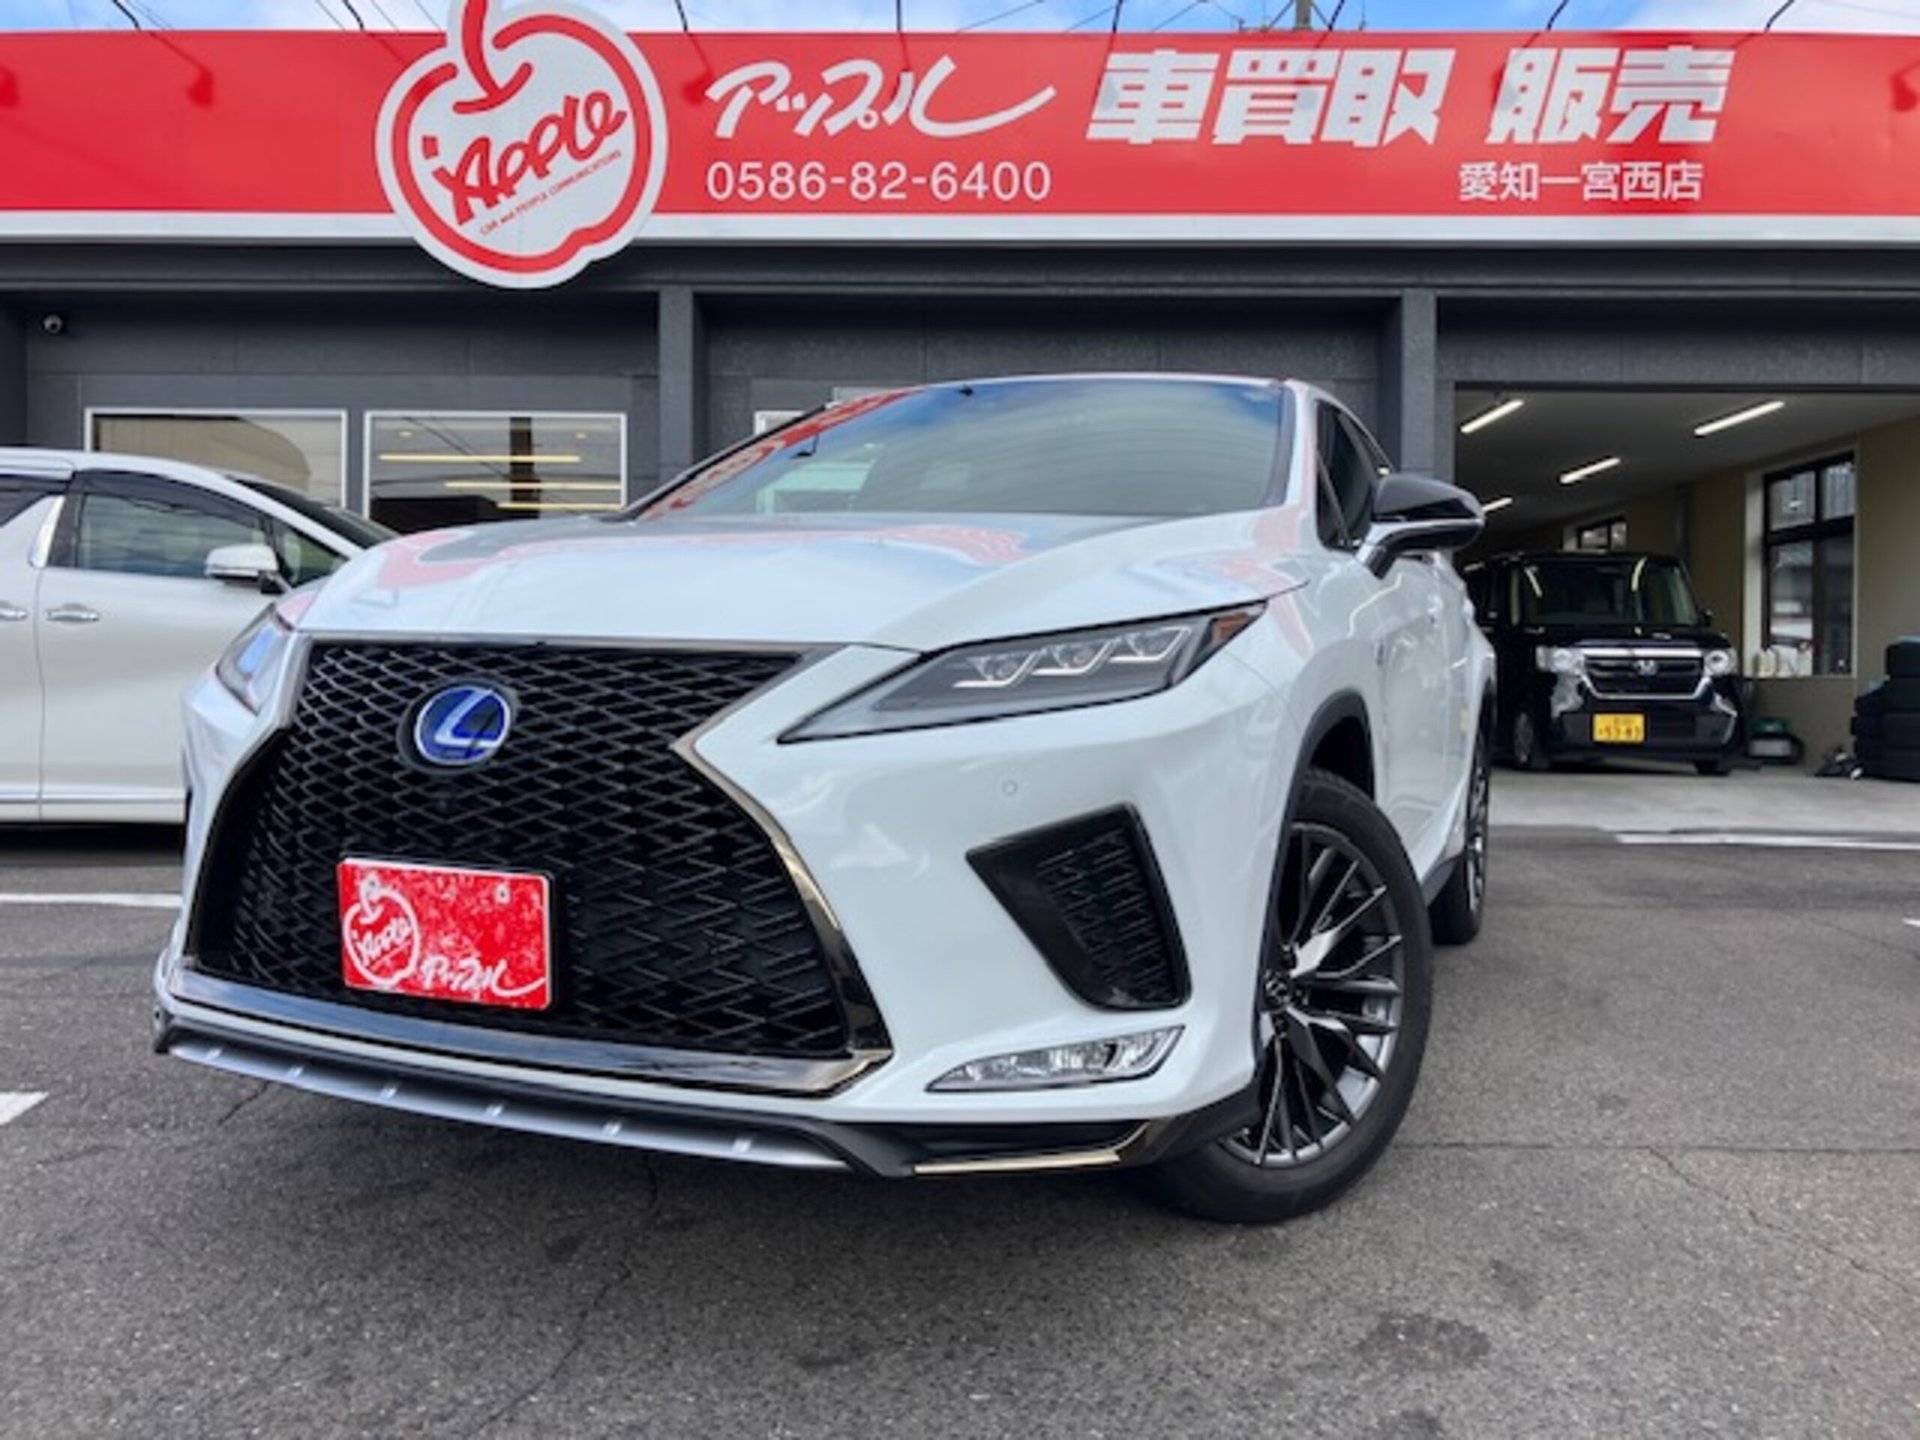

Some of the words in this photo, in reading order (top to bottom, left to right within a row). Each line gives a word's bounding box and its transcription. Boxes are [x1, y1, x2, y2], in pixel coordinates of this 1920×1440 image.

[704, 54, 1057, 139] アップル
[1086, 47, 1456, 147] 車買取
[1485, 45, 1735, 144] 販売
[706, 160, 1052, 202] 0586-82-6400
[1459, 160, 1704, 202] 愛知一宮西店
